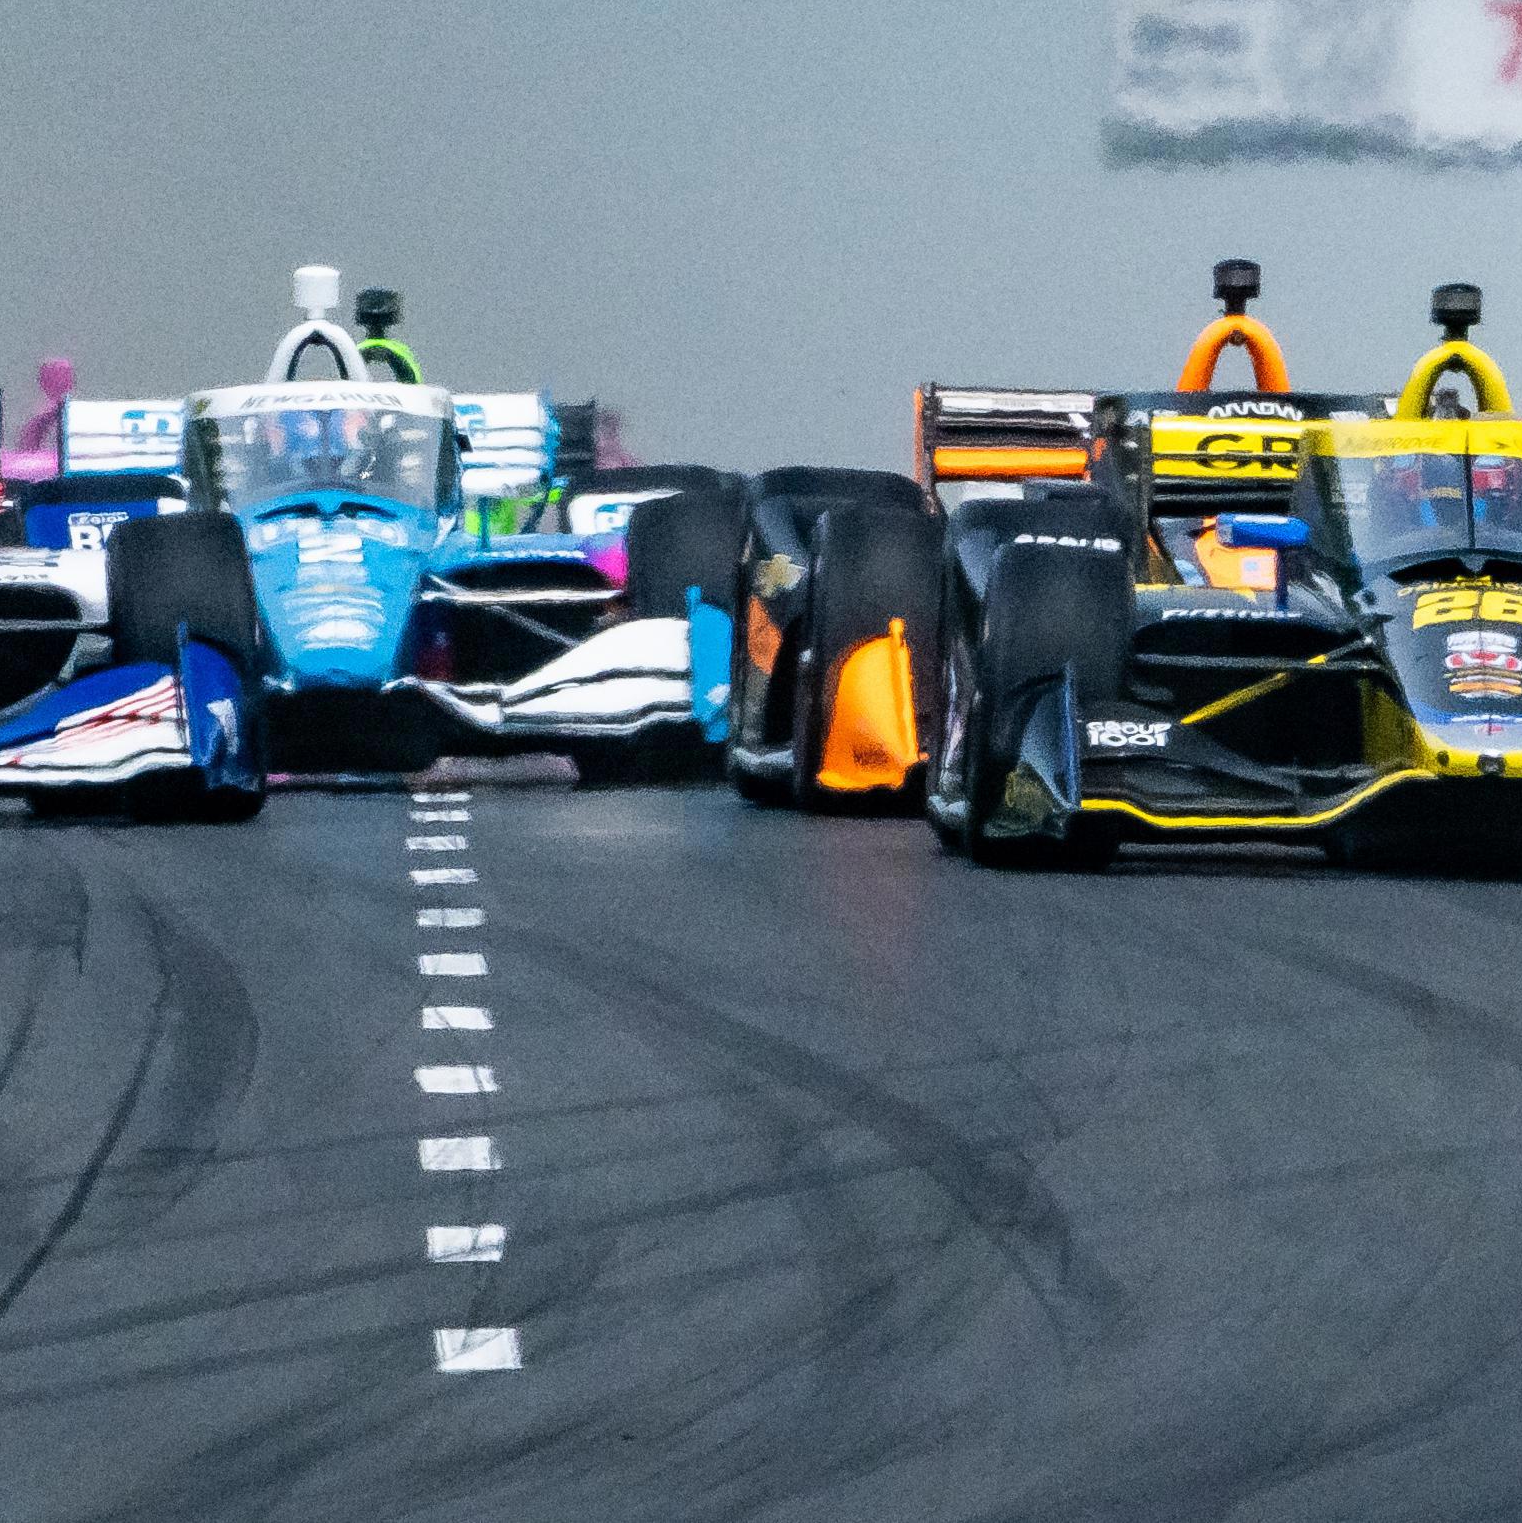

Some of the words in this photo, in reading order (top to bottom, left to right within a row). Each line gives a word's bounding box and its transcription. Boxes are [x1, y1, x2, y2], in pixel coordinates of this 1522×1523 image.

[1196, 433, 1300, 469] GR
[1085, 720, 1172, 734] GROUP
[1089, 733, 1167, 747] 1001
